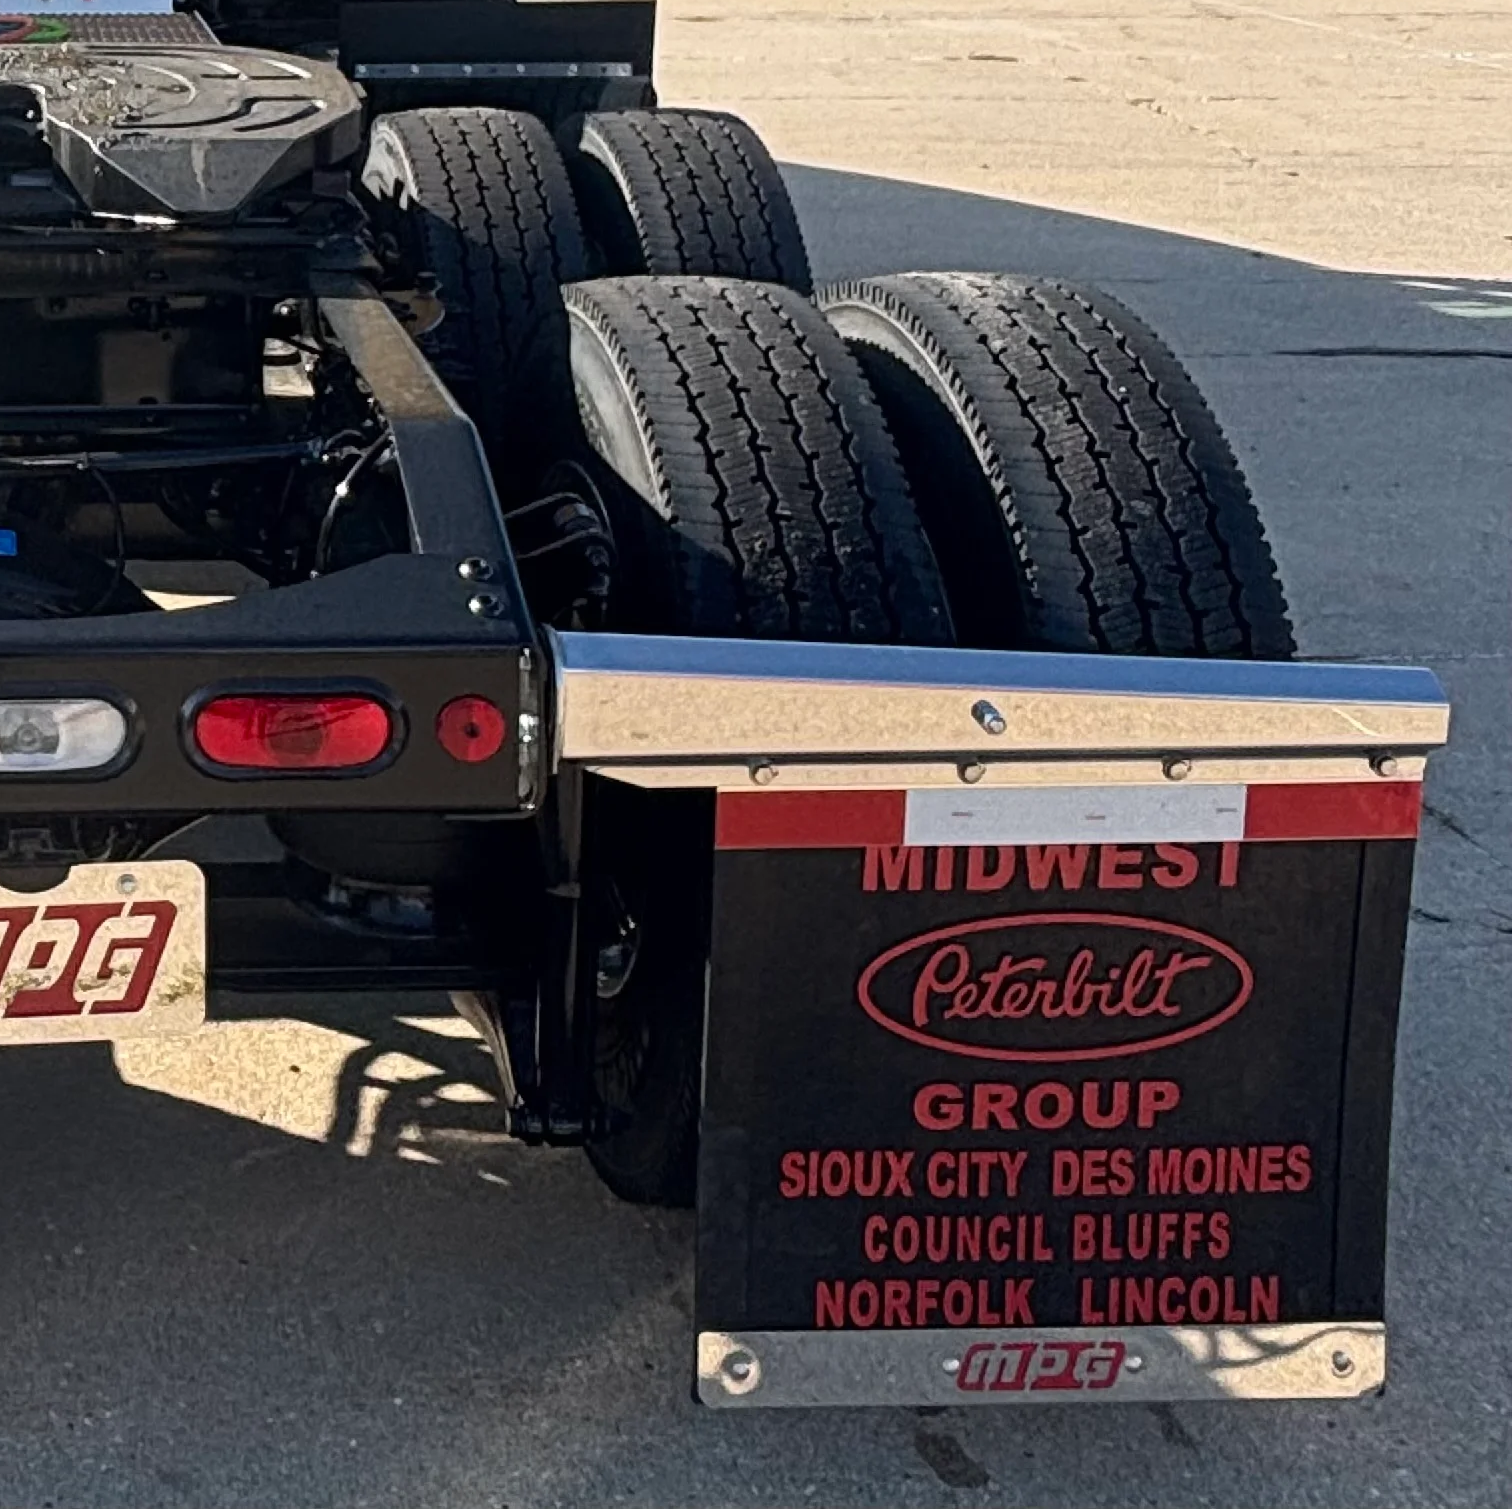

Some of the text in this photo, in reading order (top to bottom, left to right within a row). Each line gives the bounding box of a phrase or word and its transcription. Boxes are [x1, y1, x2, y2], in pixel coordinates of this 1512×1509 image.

[910, 941, 1213, 1028] Peterbilt
[913, 1080, 1181, 1131] GROUP
[779, 1144, 1312, 1199] SIOUX CITY DES MOINES
[863, 1211, 1231, 1264] COUNCIL BLUFFS
[814, 1276, 1280, 1327] NORFOLK LINCOLN
[958, 1342, 1124, 1390] MPG
